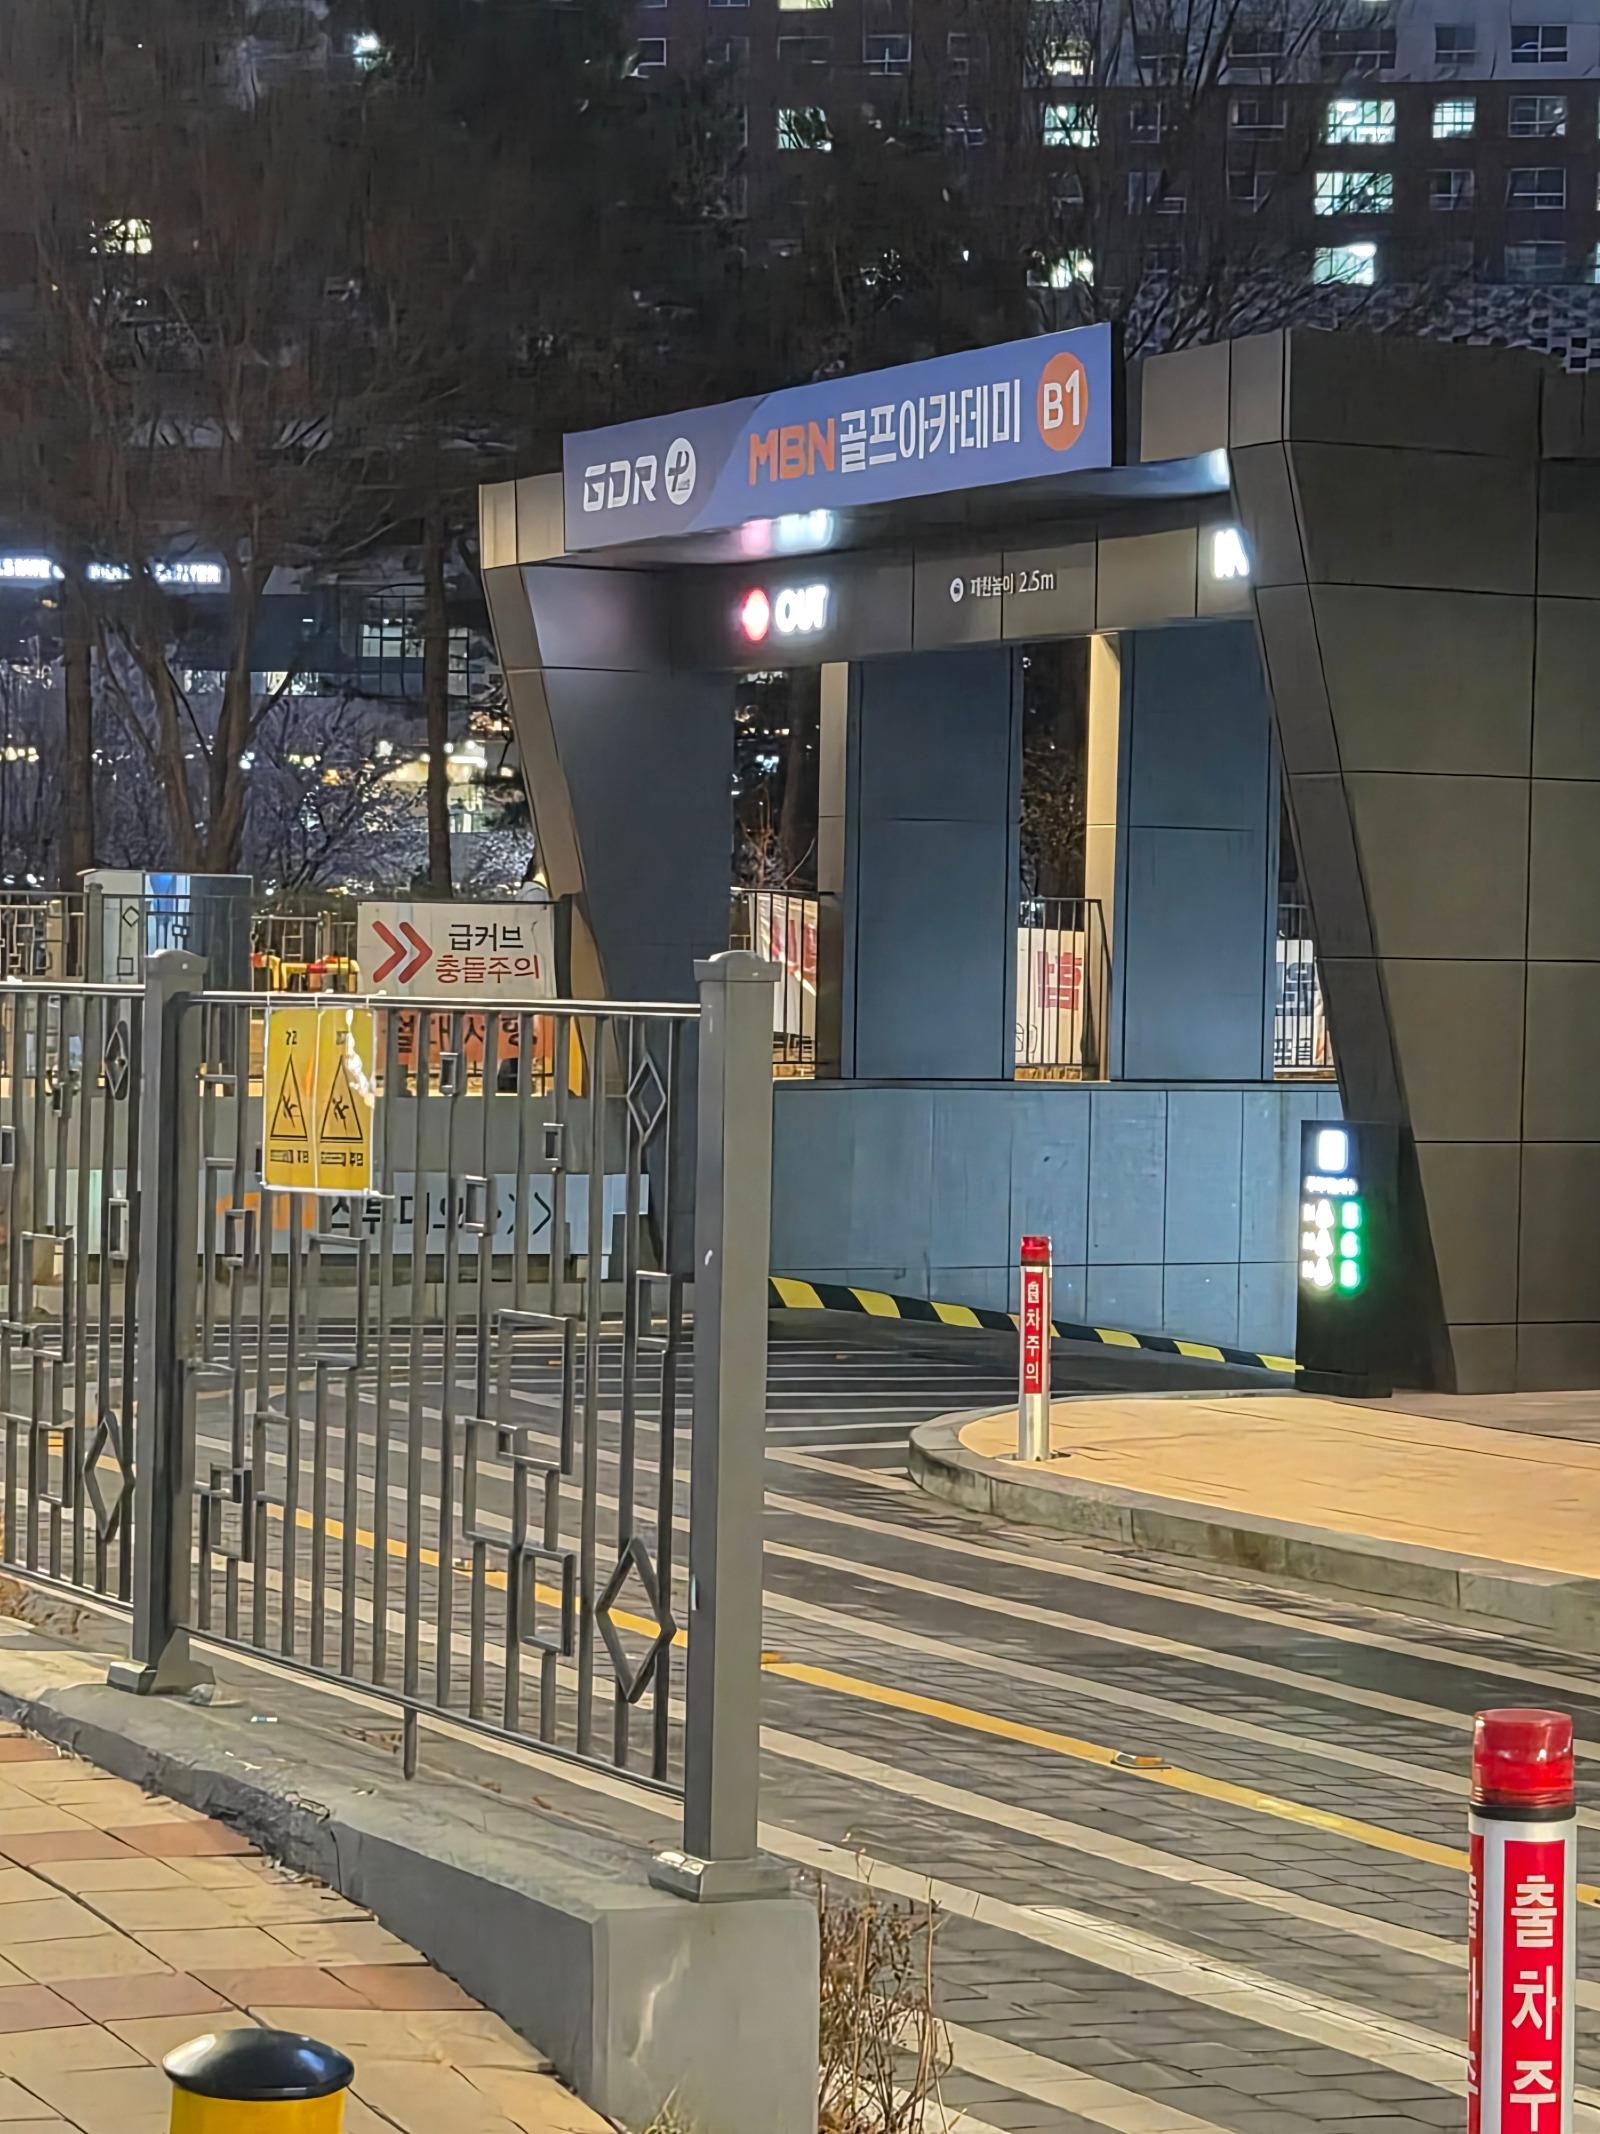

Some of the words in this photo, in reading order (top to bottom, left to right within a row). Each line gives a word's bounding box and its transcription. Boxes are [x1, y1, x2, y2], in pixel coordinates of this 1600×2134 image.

[748, 417, 835, 486] MBN
[840, 379, 1020, 473] 골프아카데미
[1043, 369, 1080, 430] B1
[583, 455, 657, 512] GDR
[449, 923, 524, 951] 급커브
[435, 954, 540, 984] 충돌주의
